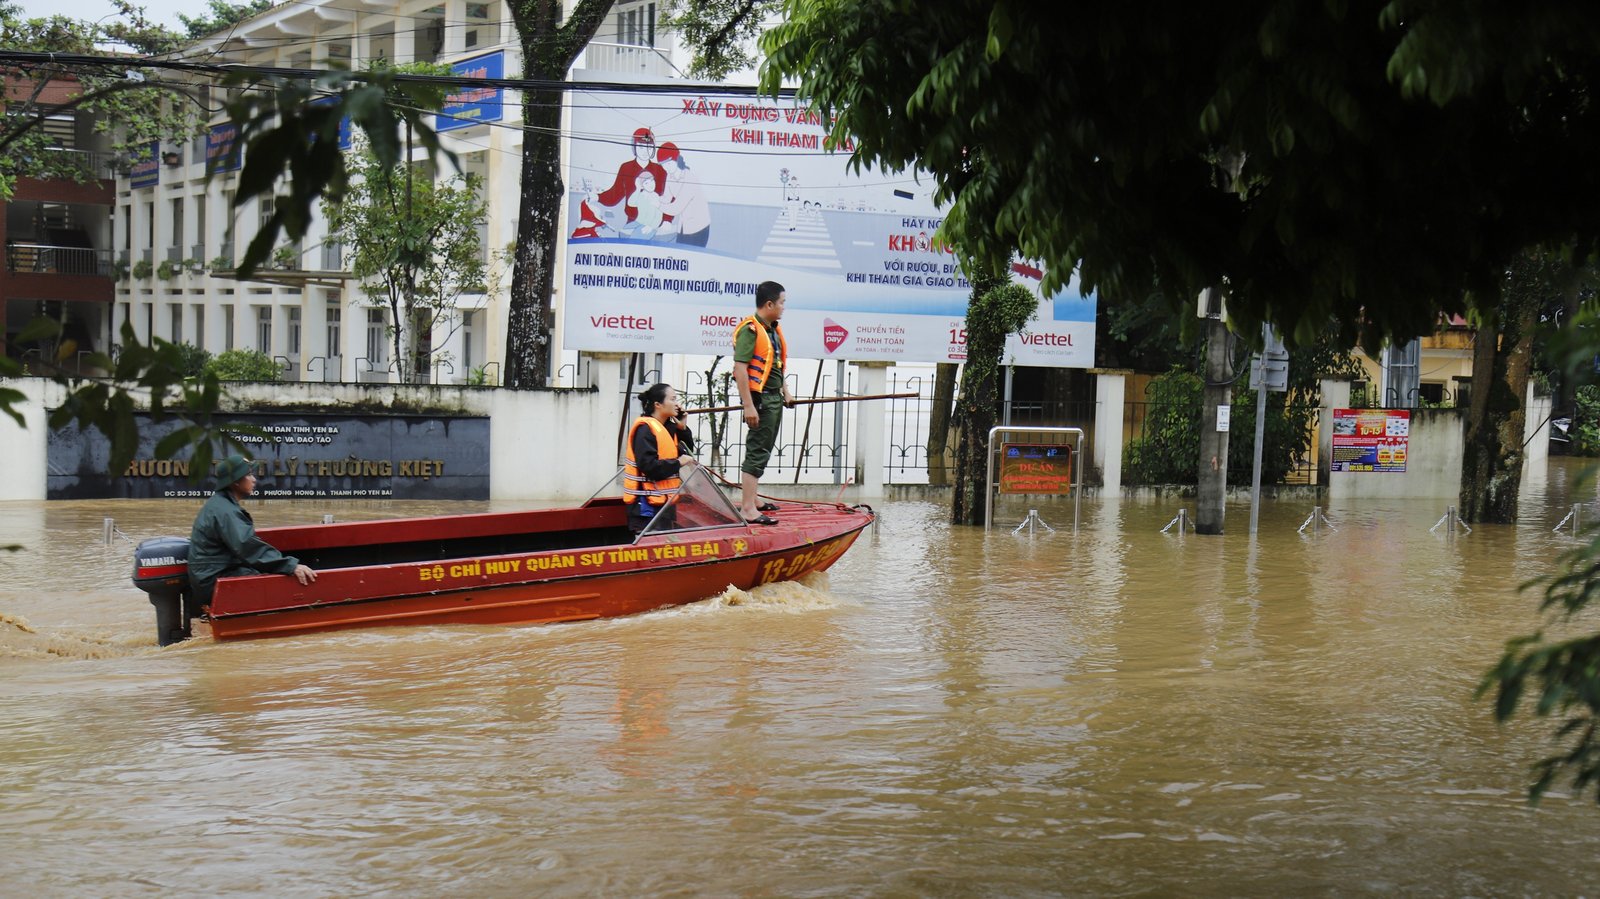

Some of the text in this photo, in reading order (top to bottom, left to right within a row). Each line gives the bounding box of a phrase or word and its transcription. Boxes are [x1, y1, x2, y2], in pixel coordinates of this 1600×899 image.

[682, 96, 721, 117] XÂY
[725, 101, 779, 124] DỰNG
[731, 127, 763, 145] KHI
[767, 130, 818, 149] THAM
[902, 216, 925, 229] HÃY
[574, 252, 689, 272] AN TOÀN GIAO THÔNG
[884, 258, 904, 271] VỚI
[573, 273, 606, 289] HẠNH
[607, 273, 637, 289] PHÚC
[639, 274, 662, 290] CỦA
[663, 278, 685, 294] MỌI
[724, 281, 746, 298] MỌI
[846, 273, 866, 284] KHI
[869, 273, 900, 285] THAM
[902, 275, 923, 286] GIA
[925, 276, 955, 287] GIAO
[590, 313, 655, 330] viettel
[700, 315, 737, 327] HOME
[702, 339, 717, 347] WIFI
[826, 336, 842, 344] pay
[856, 336, 882, 345] THANH
[1020, 332, 1073, 346] viettel
[242, 435, 263, 443] GIAO
[274, 454, 298, 476] LÝ
[140, 556, 176, 567] YAMAHA
[419, 541, 719, 581] BỘ CHỈ HUY QUÂN SỰ TỈNH YÊN BÁI
